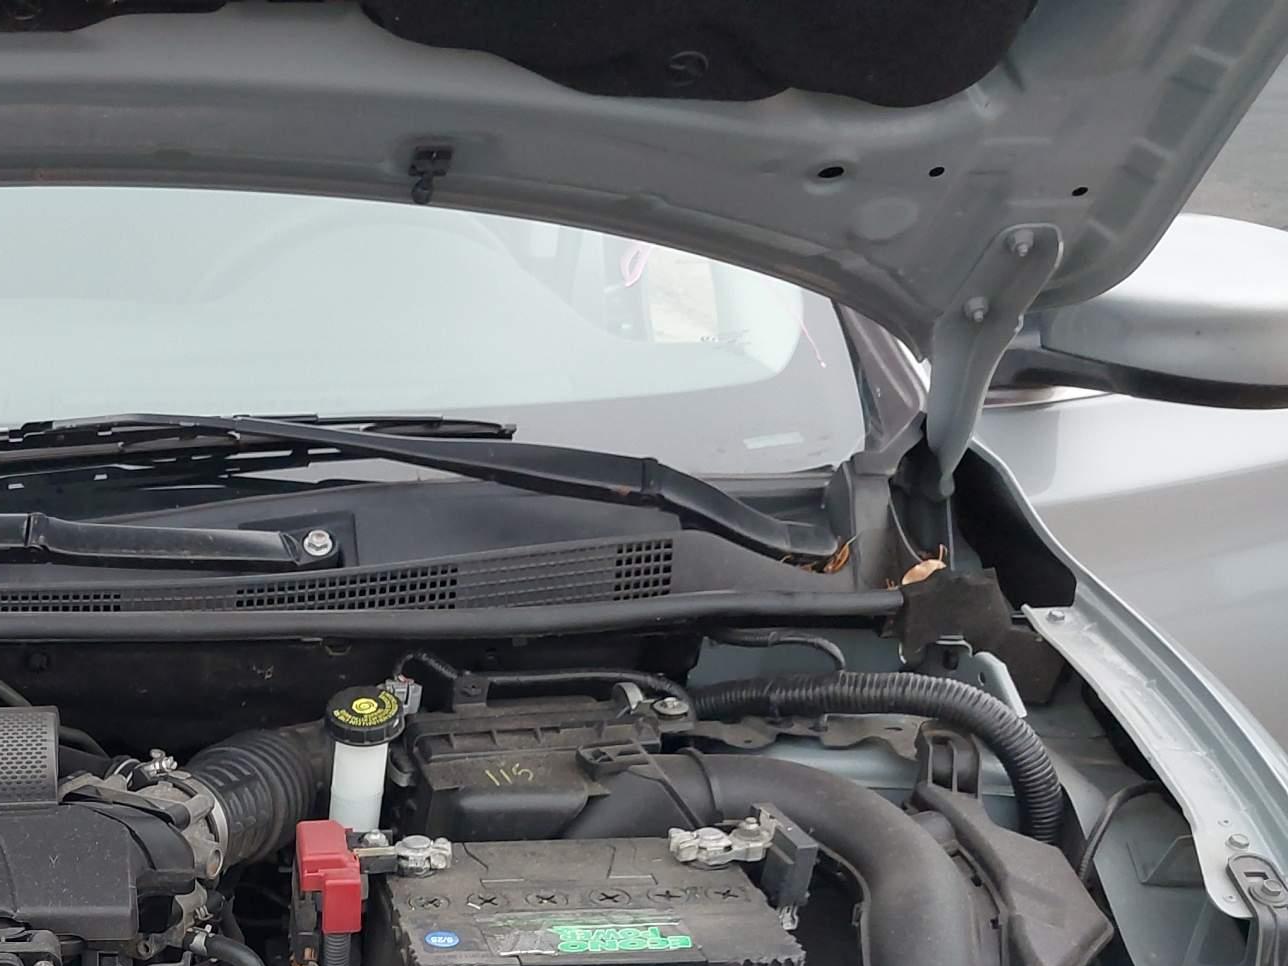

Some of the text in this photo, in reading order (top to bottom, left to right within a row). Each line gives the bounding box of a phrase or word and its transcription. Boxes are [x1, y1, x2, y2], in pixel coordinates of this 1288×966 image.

[484, 763, 534, 786] 115
[559, 927, 661, 940] POWER
[557, 936, 692, 952] ECONO
